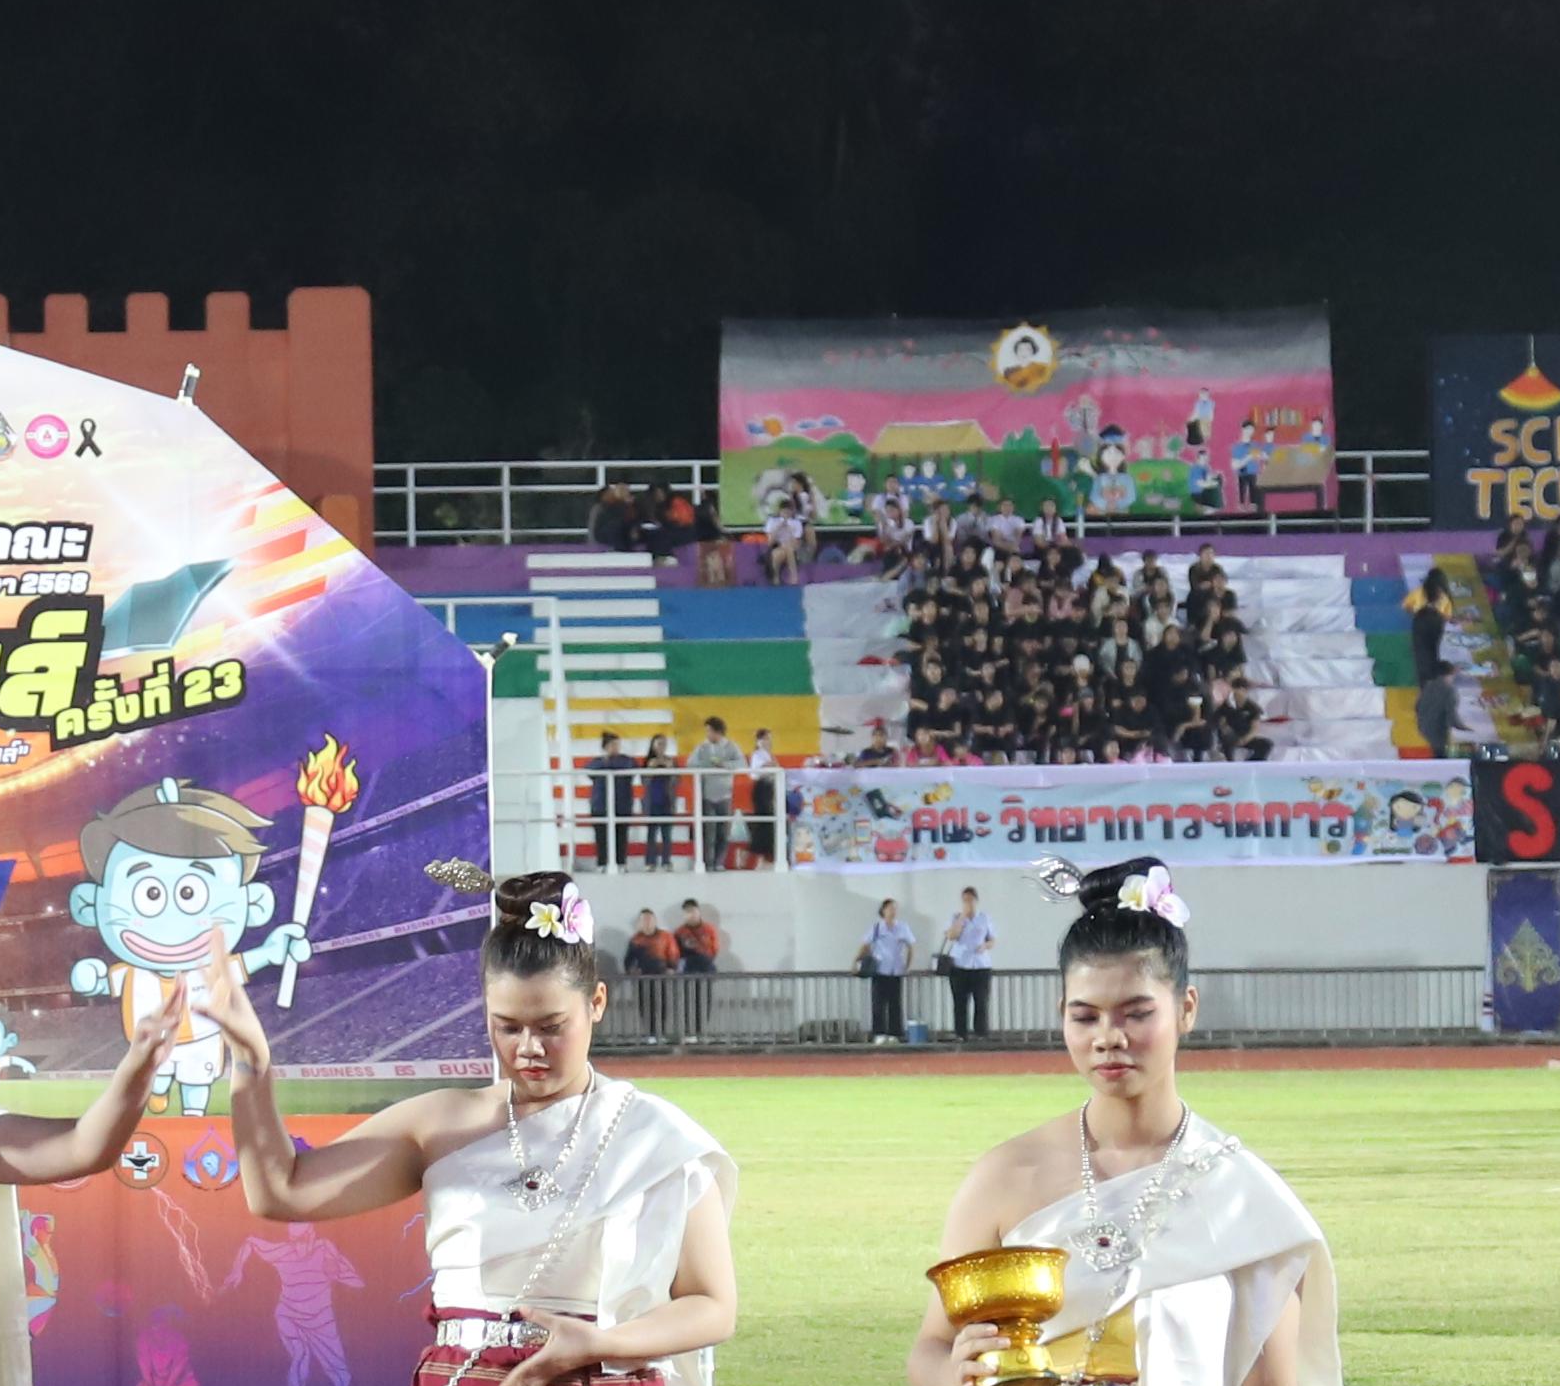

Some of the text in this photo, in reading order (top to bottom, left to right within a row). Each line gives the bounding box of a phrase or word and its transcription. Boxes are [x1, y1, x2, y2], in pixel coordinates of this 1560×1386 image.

[19, 571, 89, 594] 2568
[54, 658, 243, 741] ครั้งที่ 23
[300, 1066, 376, 1077] BUSINESS
